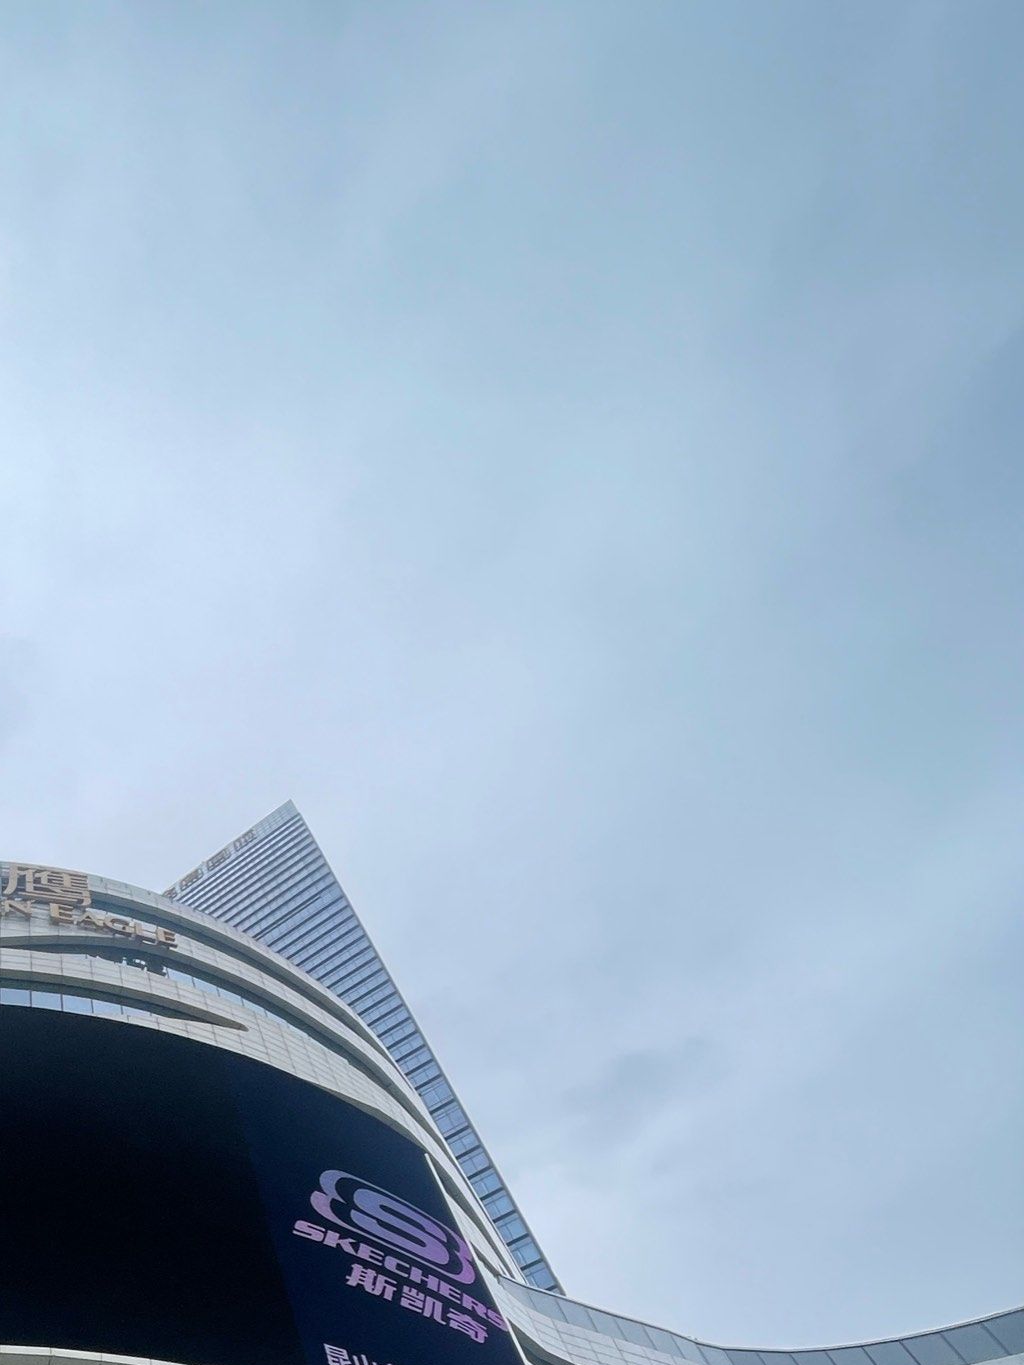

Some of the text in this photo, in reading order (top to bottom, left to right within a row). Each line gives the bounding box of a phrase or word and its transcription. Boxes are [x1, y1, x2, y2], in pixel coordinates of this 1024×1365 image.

[49, 902, 179, 948] EAGLE
[292, 1220, 510, 1332] SKECHERS
[345, 1263, 489, 1344] 斯凯奇
